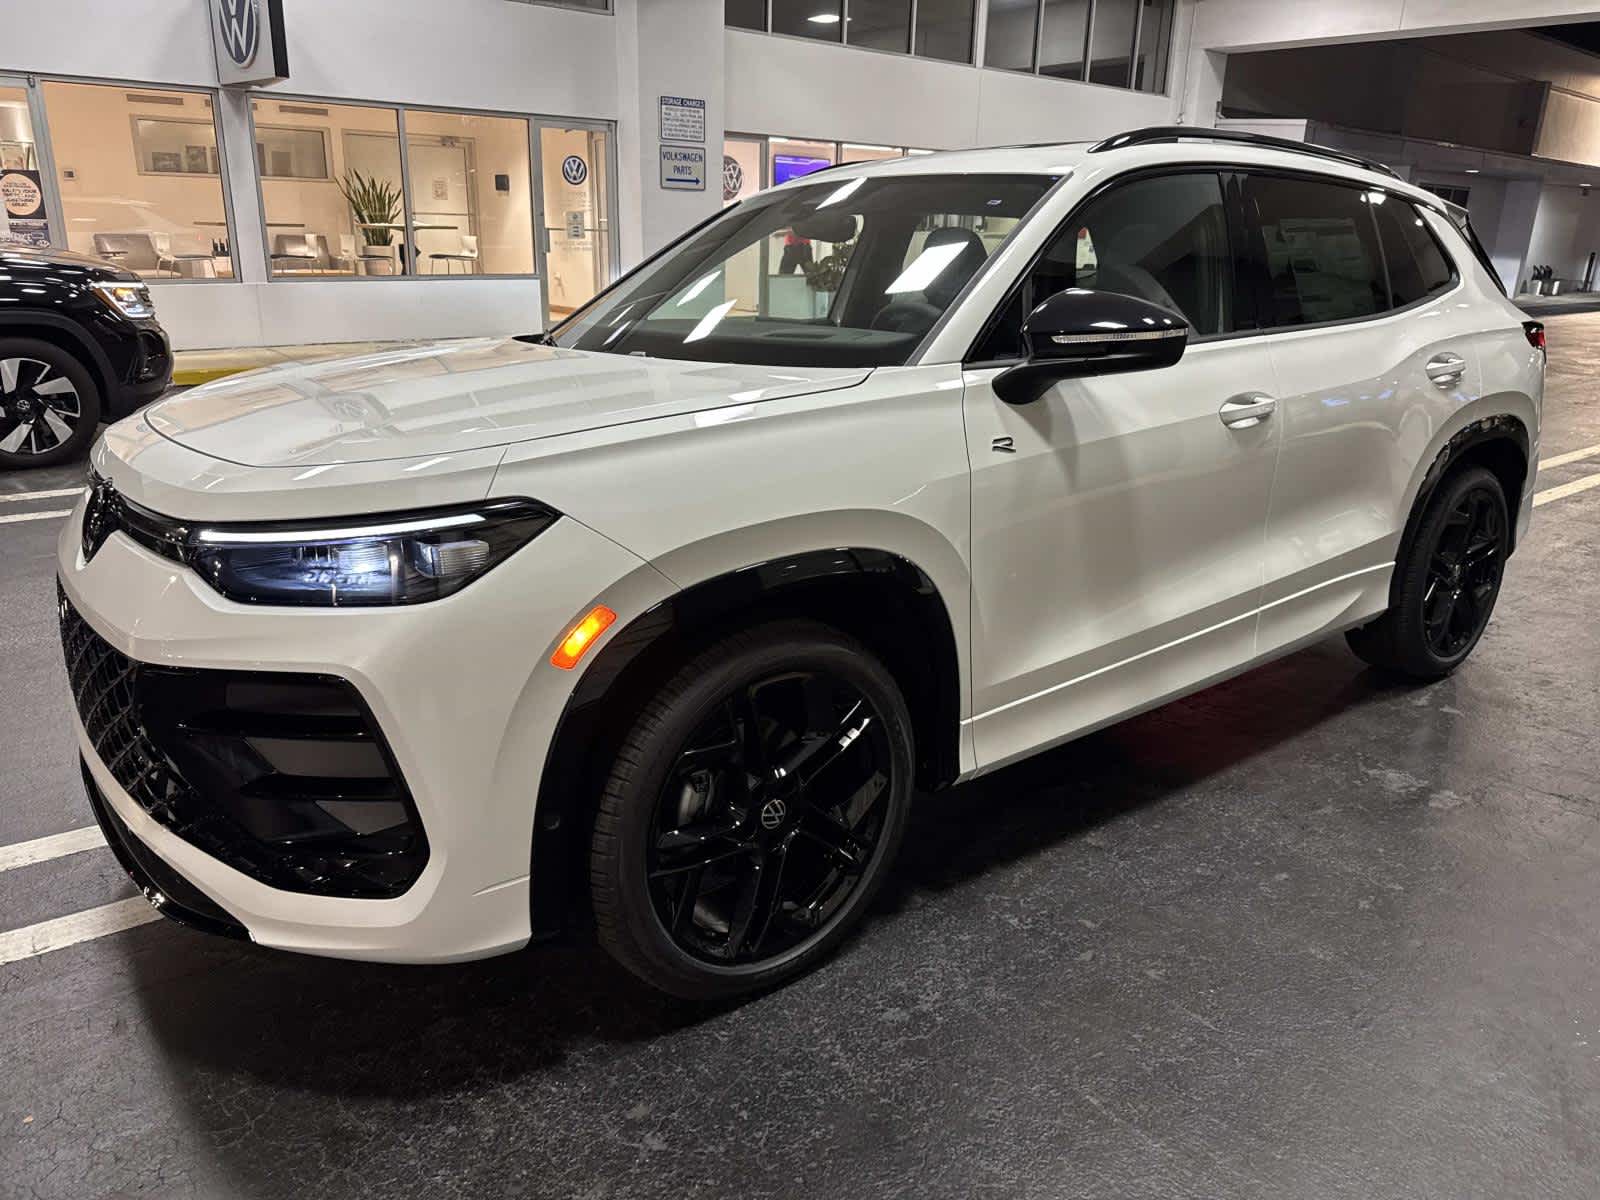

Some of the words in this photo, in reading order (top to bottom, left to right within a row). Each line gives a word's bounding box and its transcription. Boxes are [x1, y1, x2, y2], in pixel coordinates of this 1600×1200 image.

[663, 151, 703, 162] VOLKSWAGEN
[562, 155, 587, 185] VW
[673, 165, 692, 175] PARTS
[761, 799, 786, 829] VW
